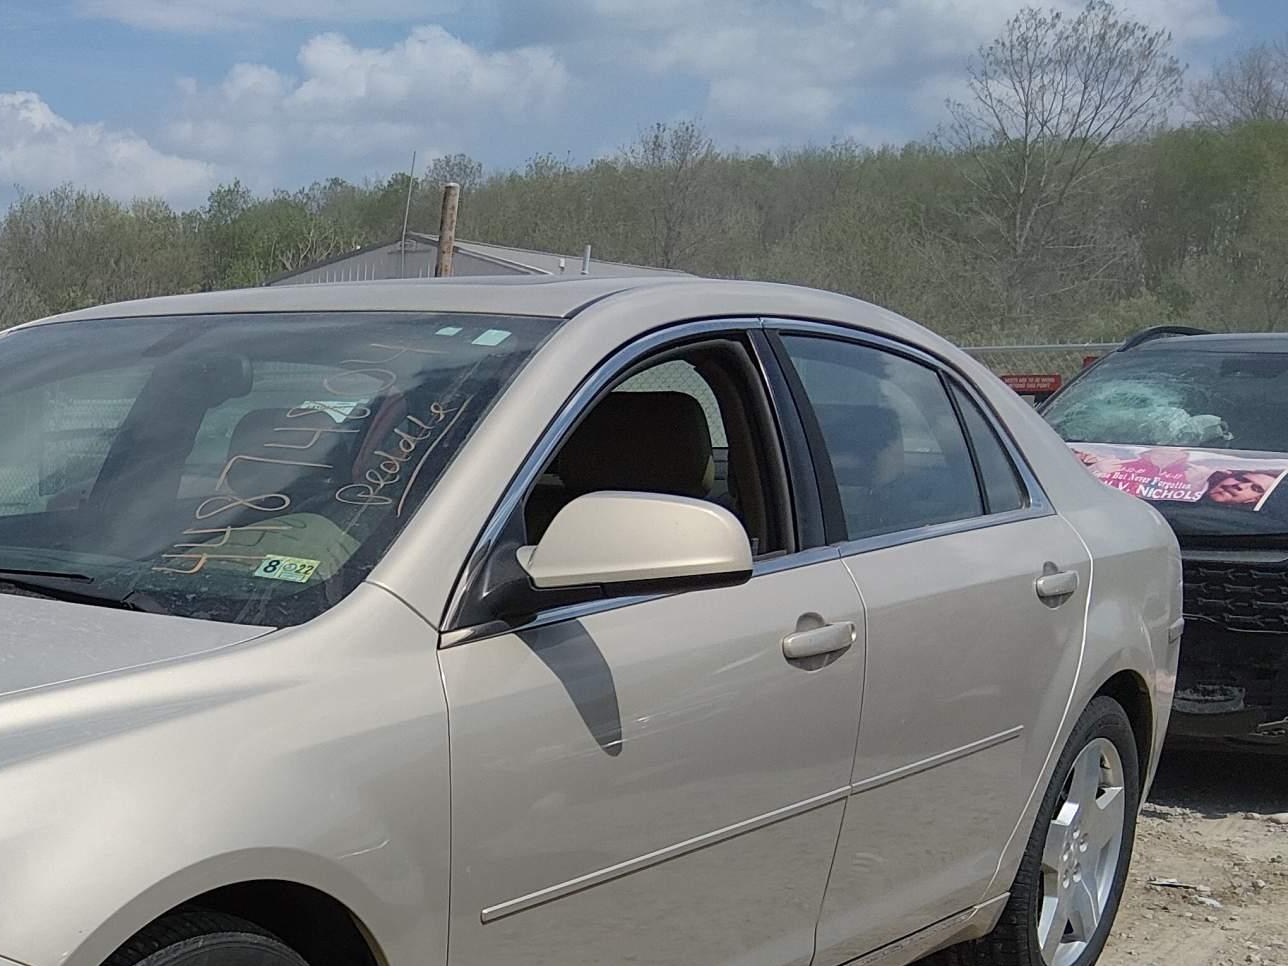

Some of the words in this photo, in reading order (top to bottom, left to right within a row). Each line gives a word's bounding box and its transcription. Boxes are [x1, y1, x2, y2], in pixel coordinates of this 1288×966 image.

[152, 343, 448, 574] 44874804
[1112, 471, 1128, 480] But
[1128, 473, 1151, 484] Never
[1151, 476, 1192, 490] Forgotten
[1136, 484, 1202, 500] NICHOLS
[263, 560, 280, 573] 8
